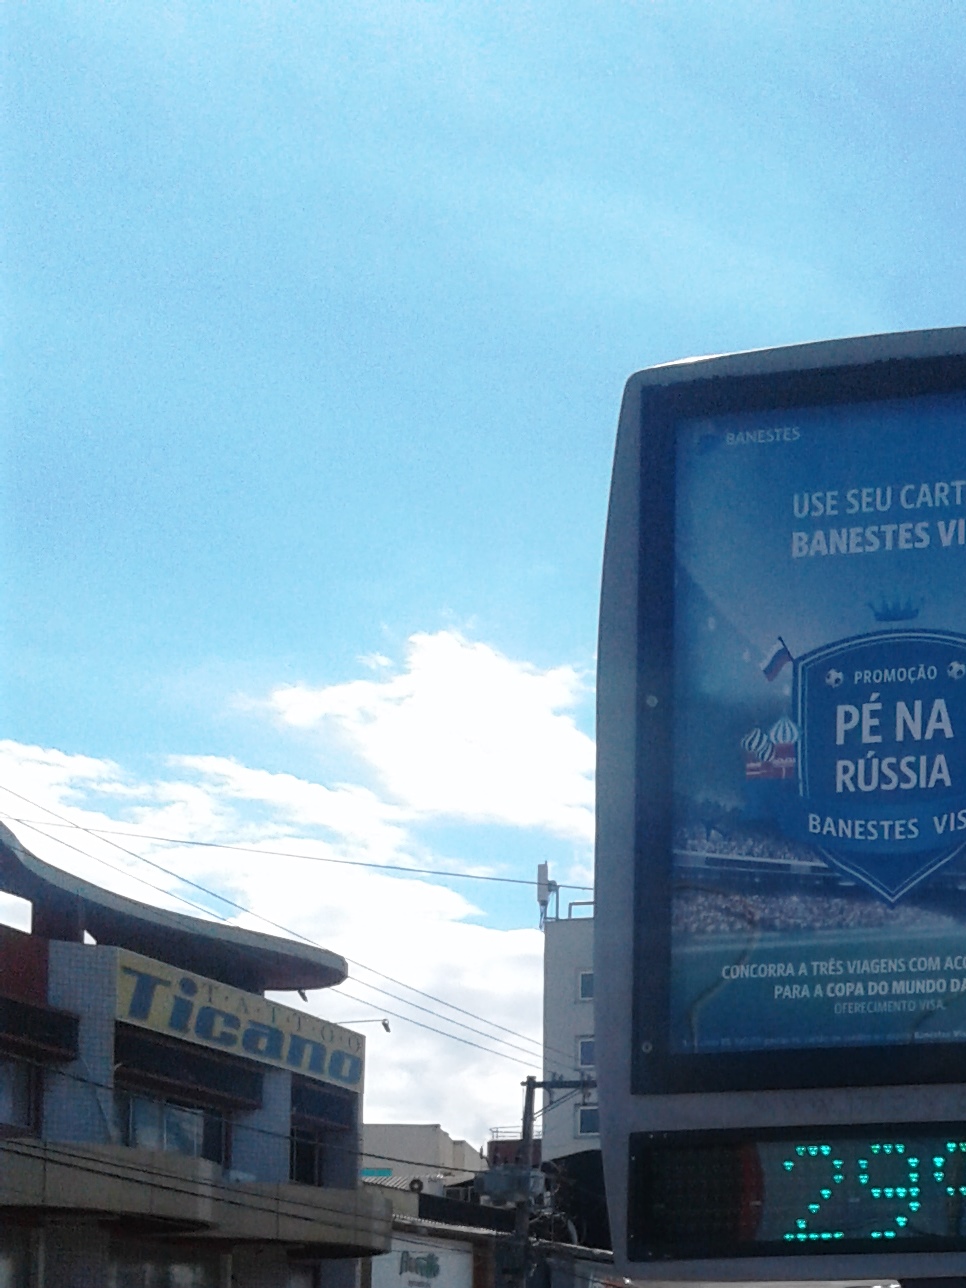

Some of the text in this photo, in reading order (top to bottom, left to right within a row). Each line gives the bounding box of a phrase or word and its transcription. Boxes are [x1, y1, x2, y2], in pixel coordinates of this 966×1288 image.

[726, 427, 801, 445] BANESTES
[793, 490, 839, 518] USE
[846, 486, 892, 513] SEU
[792, 523, 931, 558] BANESTES
[853, 664, 938, 685] PROMOÇÃO
[835, 692, 954, 745] PÉ NA
[835, 750, 952, 793] RÚSSIA
[807, 813, 919, 841] BANESTES
[721, 963, 795, 980] CONCORRA
[799, 962, 808, 976] A
[811, 957, 844, 976] TRÊS
[847, 957, 906, 975] VIAGENS
[909, 957, 941, 973] COM
[774, 984, 810, 1000] PARA
[813, 983, 824, 997] A
[826, 980, 864, 998] COPA
[867, 979, 889, 996] DO
[892, 978, 947, 996] MUNDO
[834, 1001, 916, 1016] OFERECIMENTO
[120, 966, 364, 1086] Ticano
